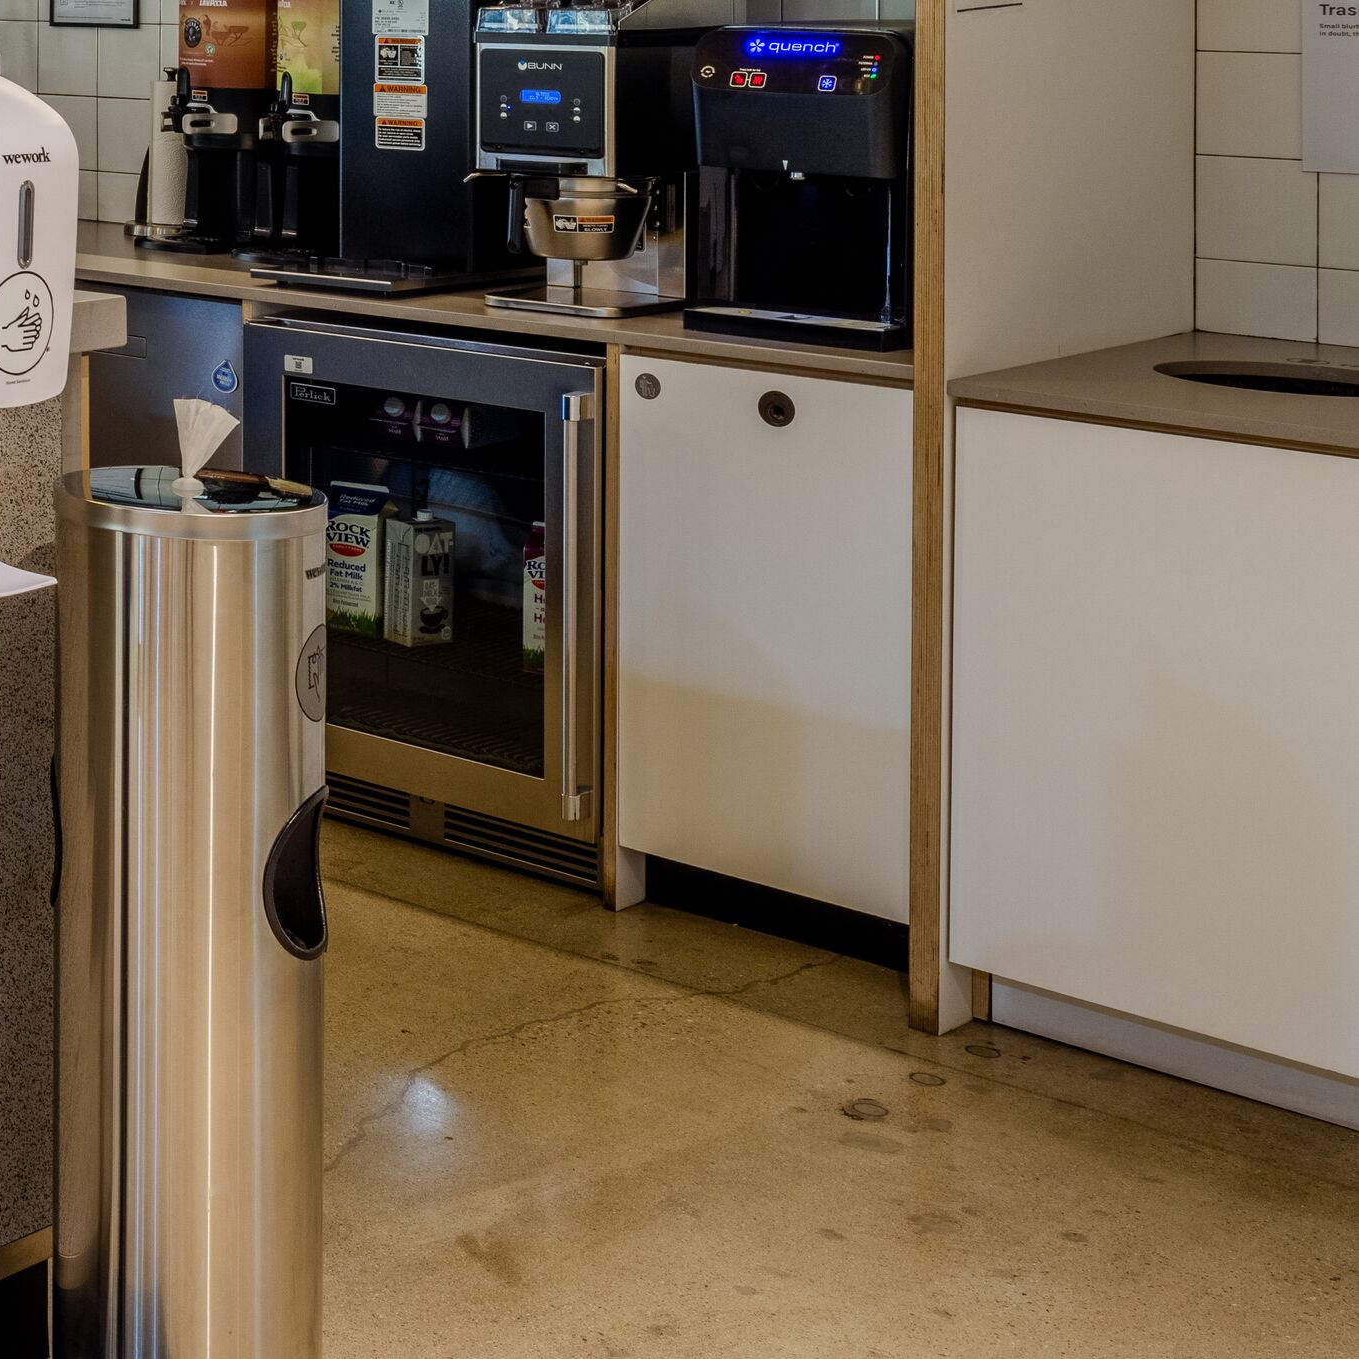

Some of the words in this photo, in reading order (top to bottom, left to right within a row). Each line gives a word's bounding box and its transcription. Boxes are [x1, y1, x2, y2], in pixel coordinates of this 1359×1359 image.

[1318, 3, 1357, 16] Tras
[768, 41, 836, 53] quench
[527, 62, 562, 70] BUNN
[387, 86, 421, 94] WARNING
[2, 146, 52, 165] wework
[294, 386, 332, 402] Perlick
[326, 520, 371, 539] ROCK
[414, 531, 454, 555] OAT
[327, 558, 366, 573] Reduced
[421, 553, 450, 576] LY!
[329, 567, 343, 577] Fat
[345, 570, 363, 580] Milk
[329, 581, 340, 589] 2%
[340, 583, 362, 593] Milkfat
